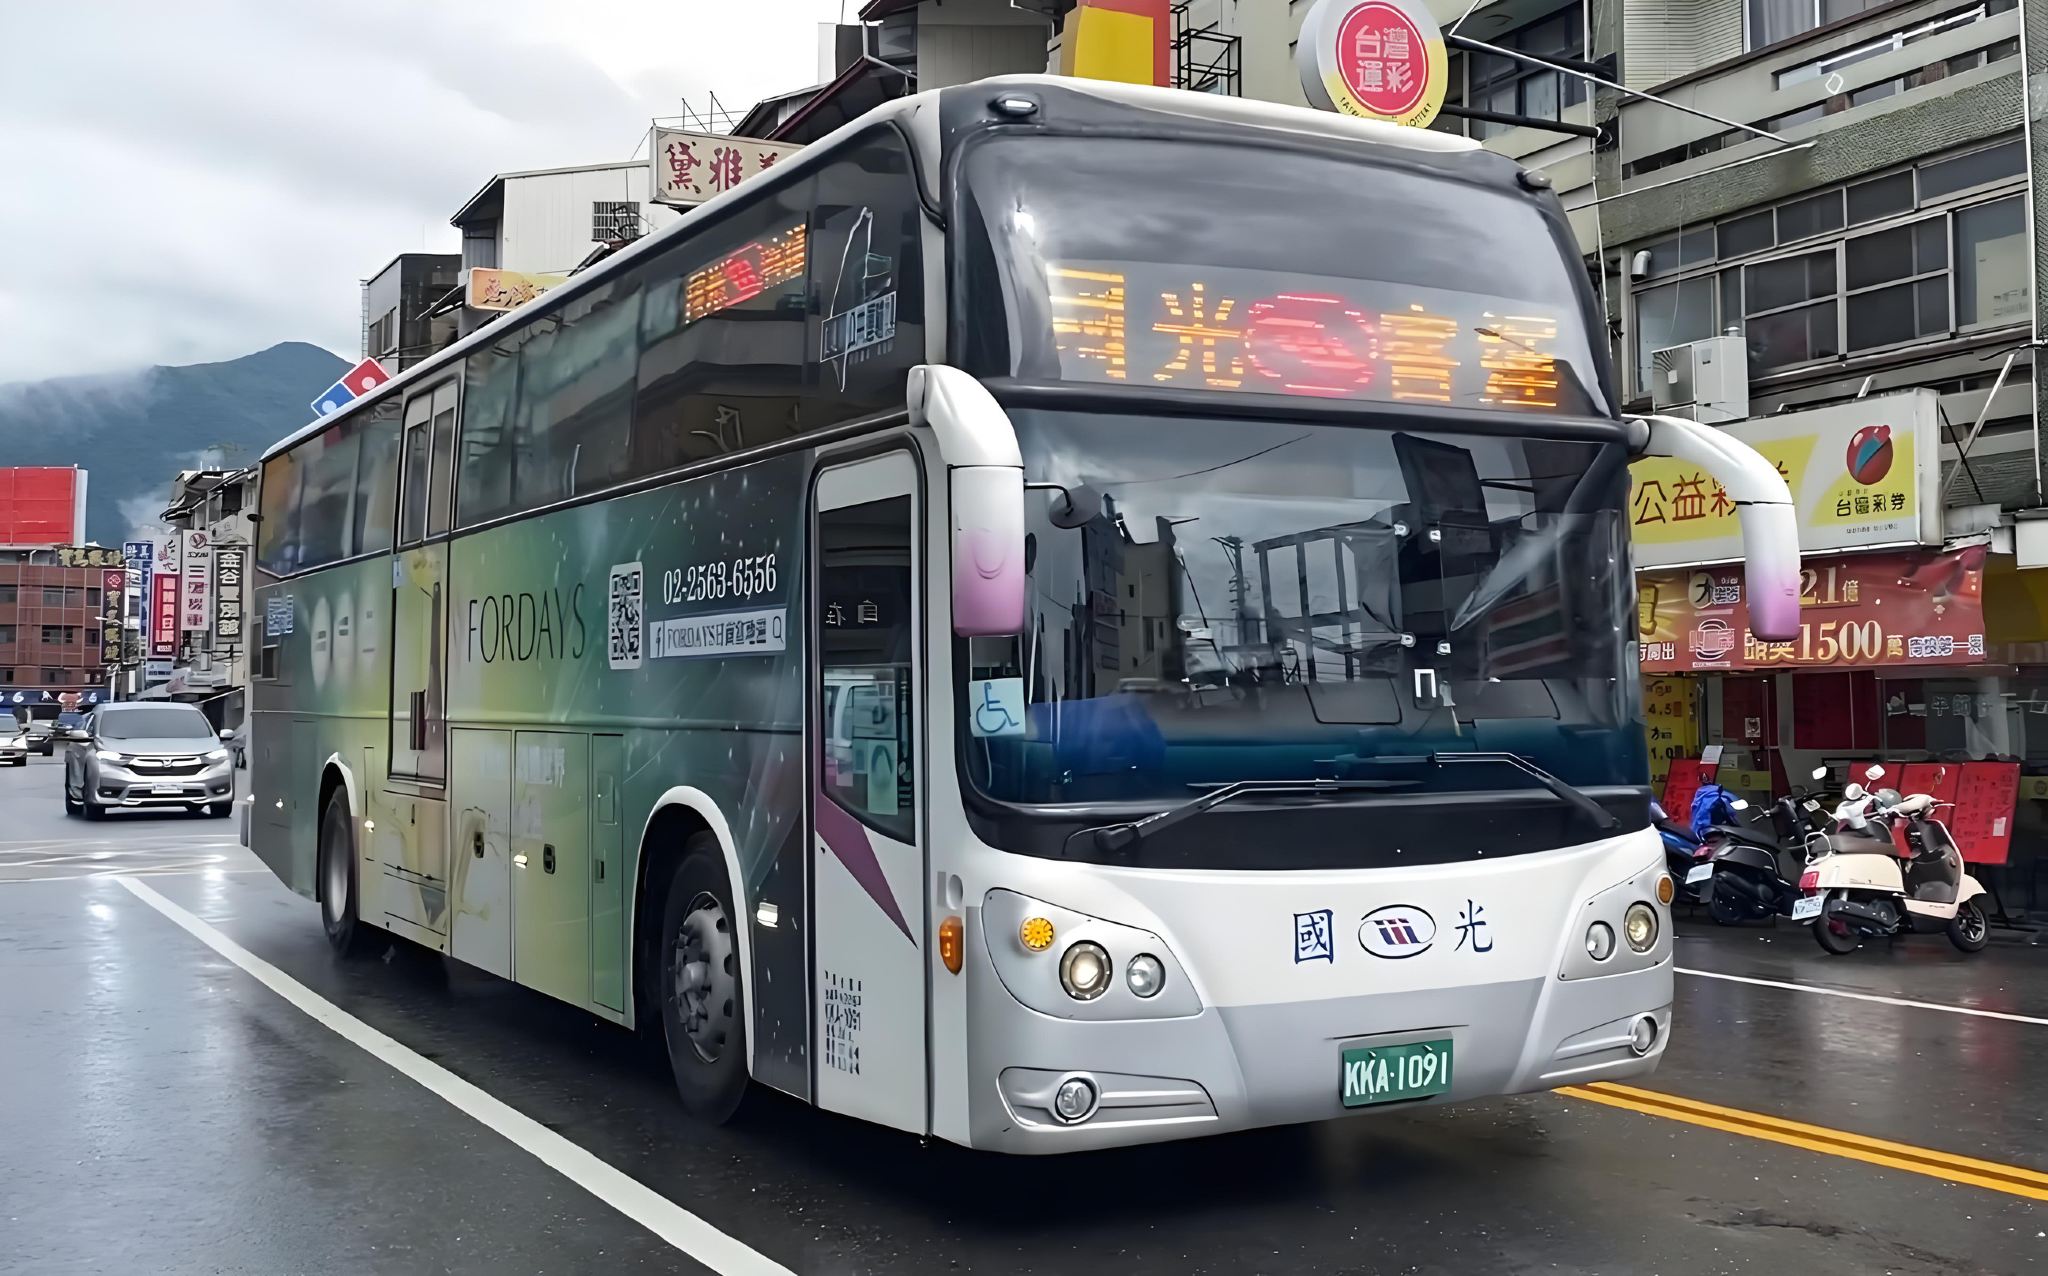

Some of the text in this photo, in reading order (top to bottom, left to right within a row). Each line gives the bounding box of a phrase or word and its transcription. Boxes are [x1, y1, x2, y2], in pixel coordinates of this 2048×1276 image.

[1356, 60, 1414, 94] 運彩
[663, 553, 777, 605] 02-2563-6556
[468, 583, 586, 664] FORDAYS
[1293, 898, 1493, 965] 國 光
